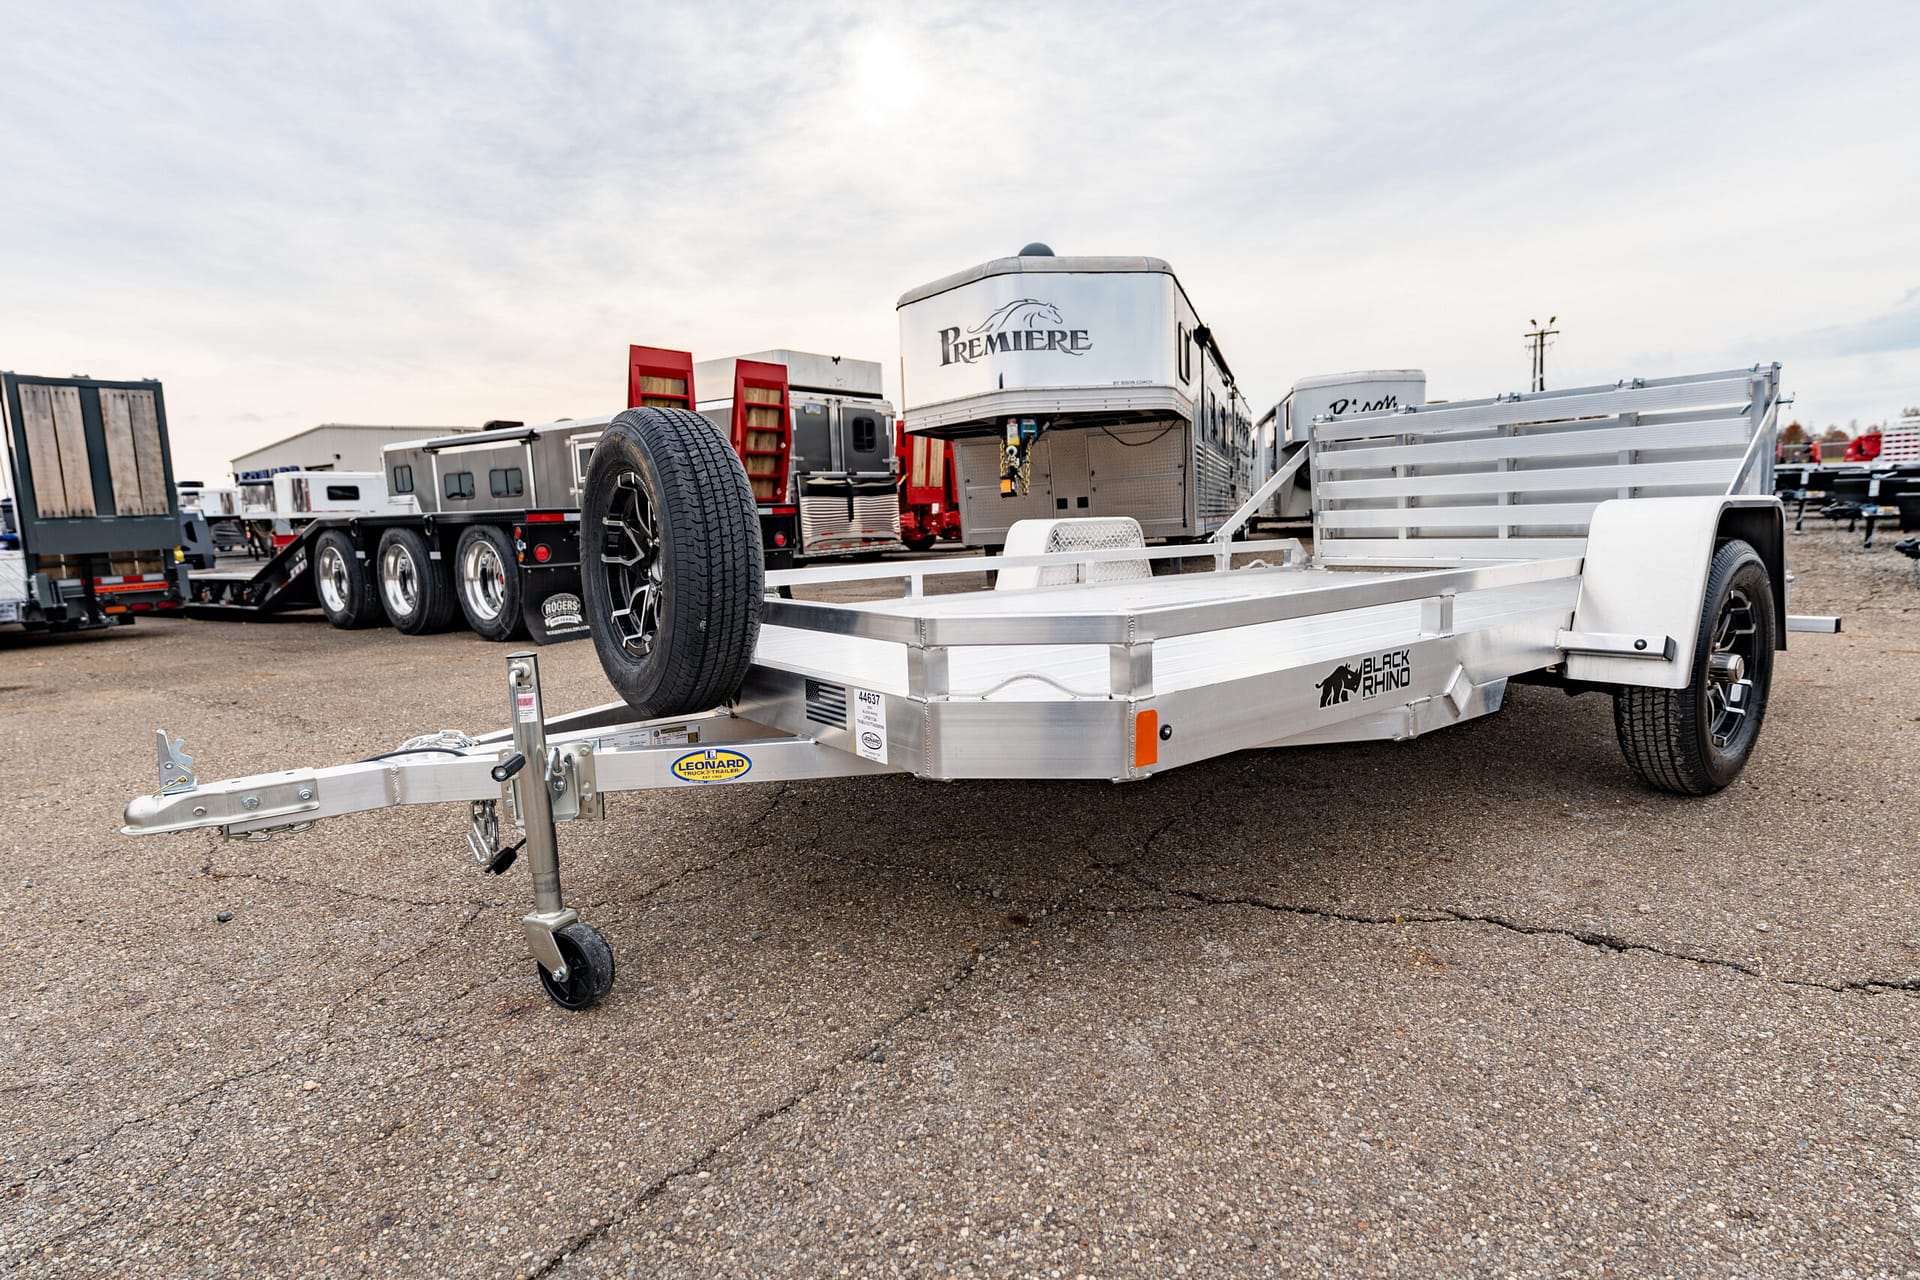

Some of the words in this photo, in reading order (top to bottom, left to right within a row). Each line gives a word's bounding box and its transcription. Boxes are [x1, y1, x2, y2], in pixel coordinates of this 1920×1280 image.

[938, 326, 1093, 367] PREMIERE
[546, 600, 578, 614] ROGERS
[1363, 649, 1410, 675] BLACK
[1363, 667, 1410, 697] RHINO
[858, 691, 880, 706] 44637
[678, 759, 744, 771] LEONARD
